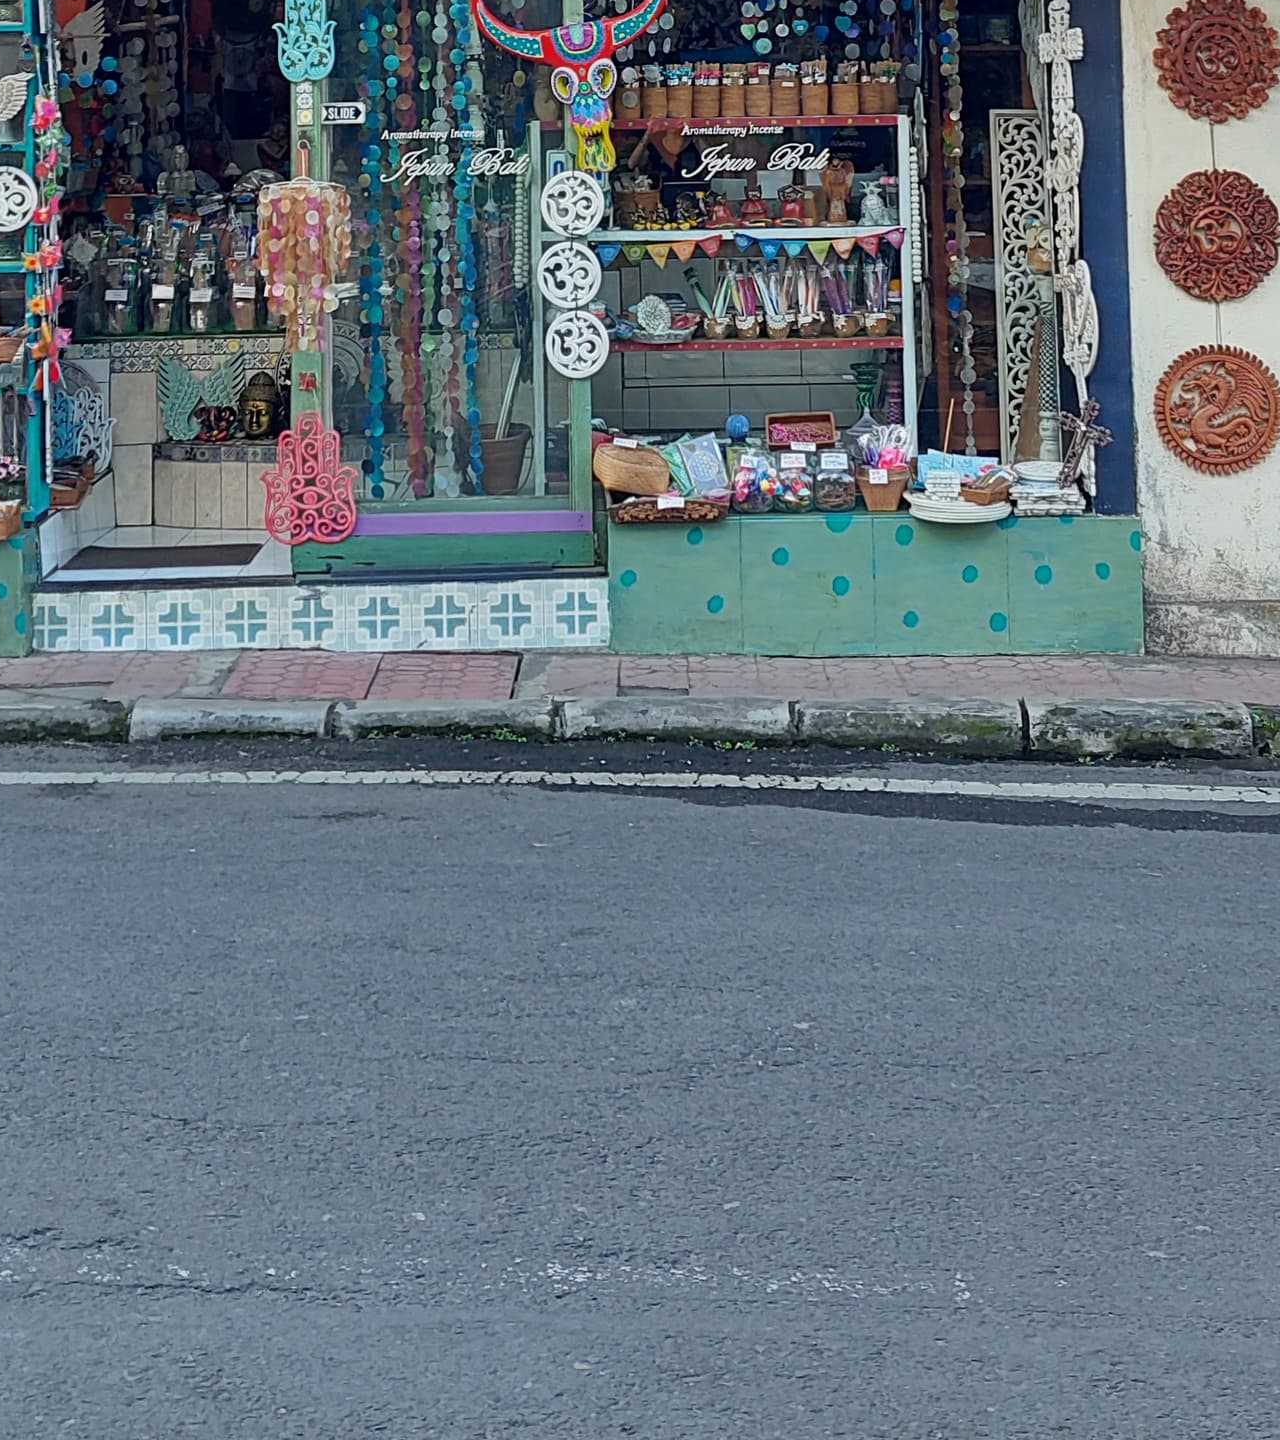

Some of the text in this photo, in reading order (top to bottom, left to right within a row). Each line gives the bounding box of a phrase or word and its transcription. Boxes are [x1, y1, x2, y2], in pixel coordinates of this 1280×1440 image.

[327, 106, 357, 120] SLIDE
[381, 129, 448, 141] Aromatherapy
[681, 123, 784, 138] Aromatherapy Incense
[380, 147, 456, 186] Jepun
[467, 147, 530, 176] Bali
[681, 143, 830, 181] Jepun Bali
